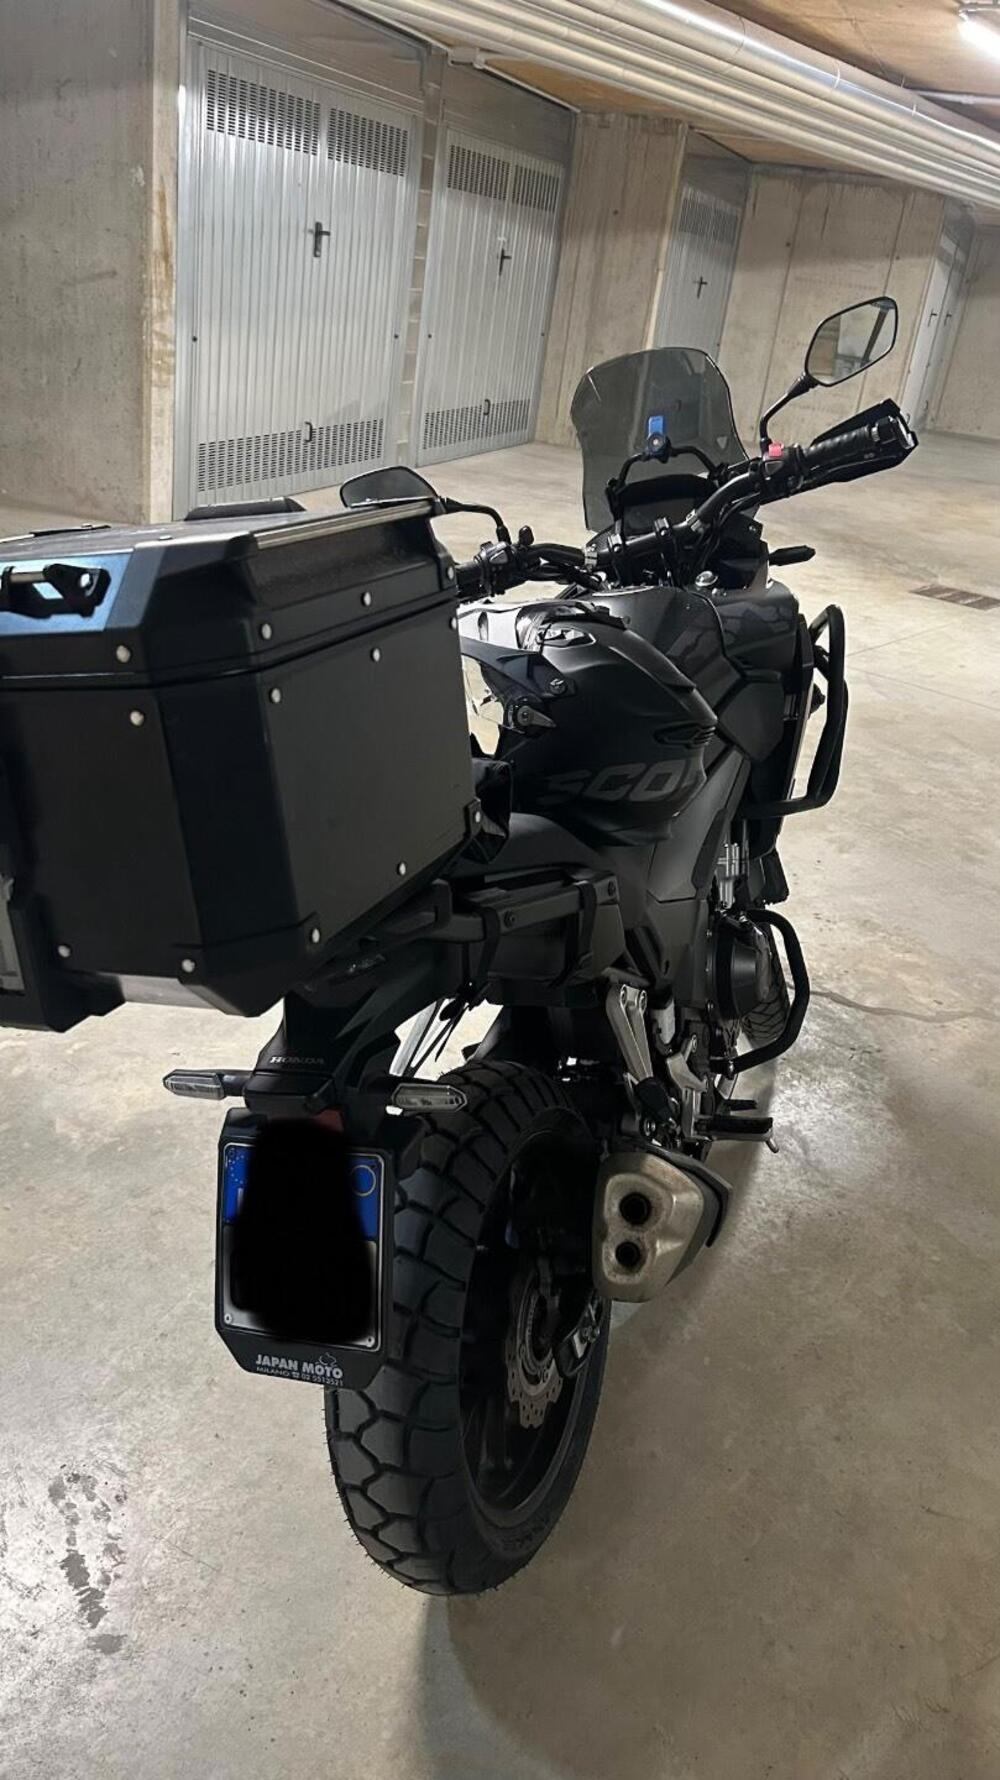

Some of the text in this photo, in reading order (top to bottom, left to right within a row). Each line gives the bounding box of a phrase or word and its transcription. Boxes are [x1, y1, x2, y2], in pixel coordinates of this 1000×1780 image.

[269, 1056, 324, 1065] HONDA
[255, 1354, 343, 1379] JAPAN MOTO
[256, 1366, 290, 1377] MILANO
